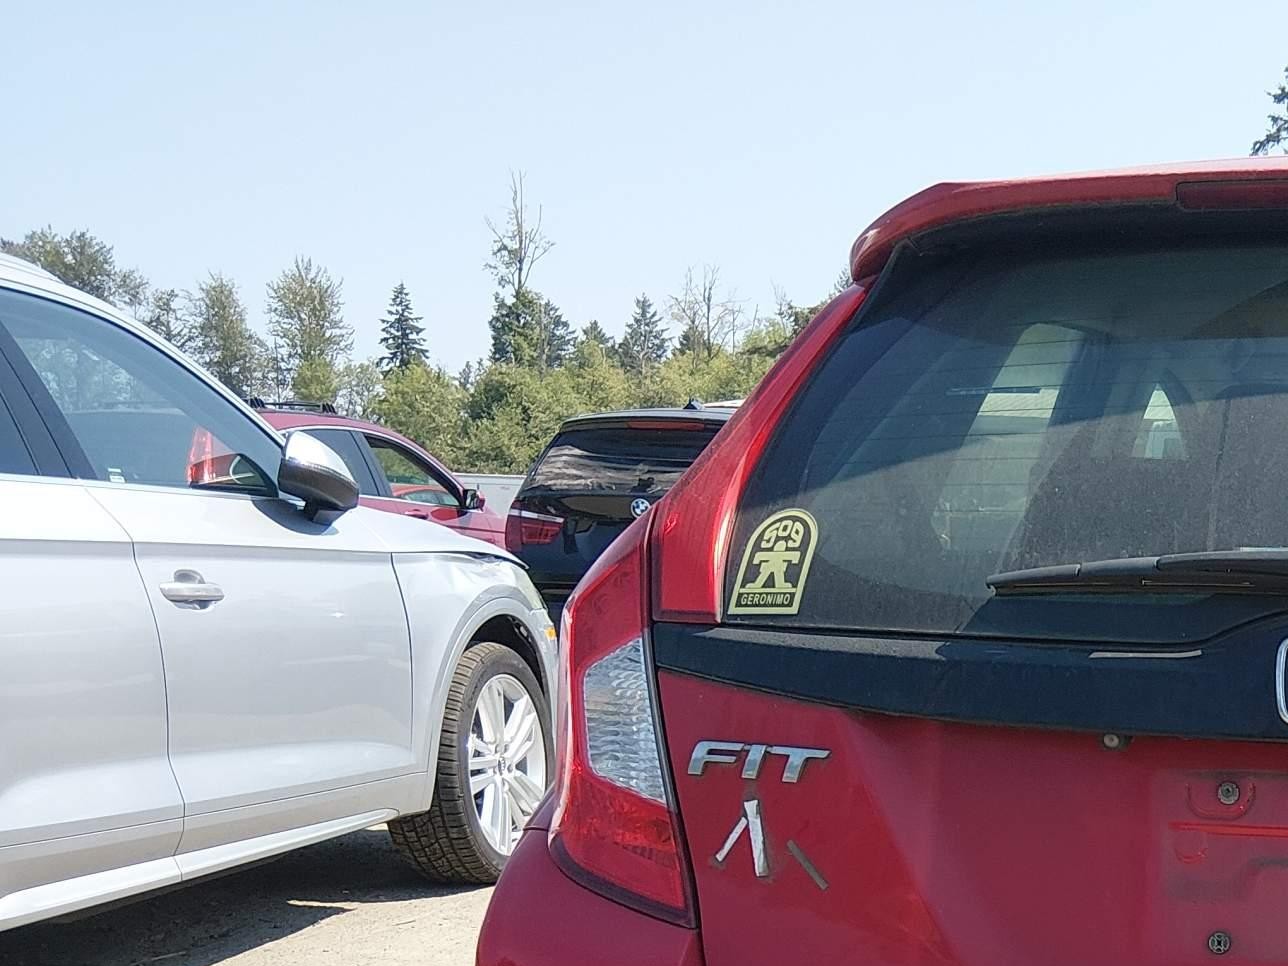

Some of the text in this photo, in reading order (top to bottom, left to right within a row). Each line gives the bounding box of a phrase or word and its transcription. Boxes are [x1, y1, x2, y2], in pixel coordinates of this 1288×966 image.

[761, 519, 804, 548] 509
[741, 593, 791, 605] GERONIMO
[687, 740, 832, 783] FIT
